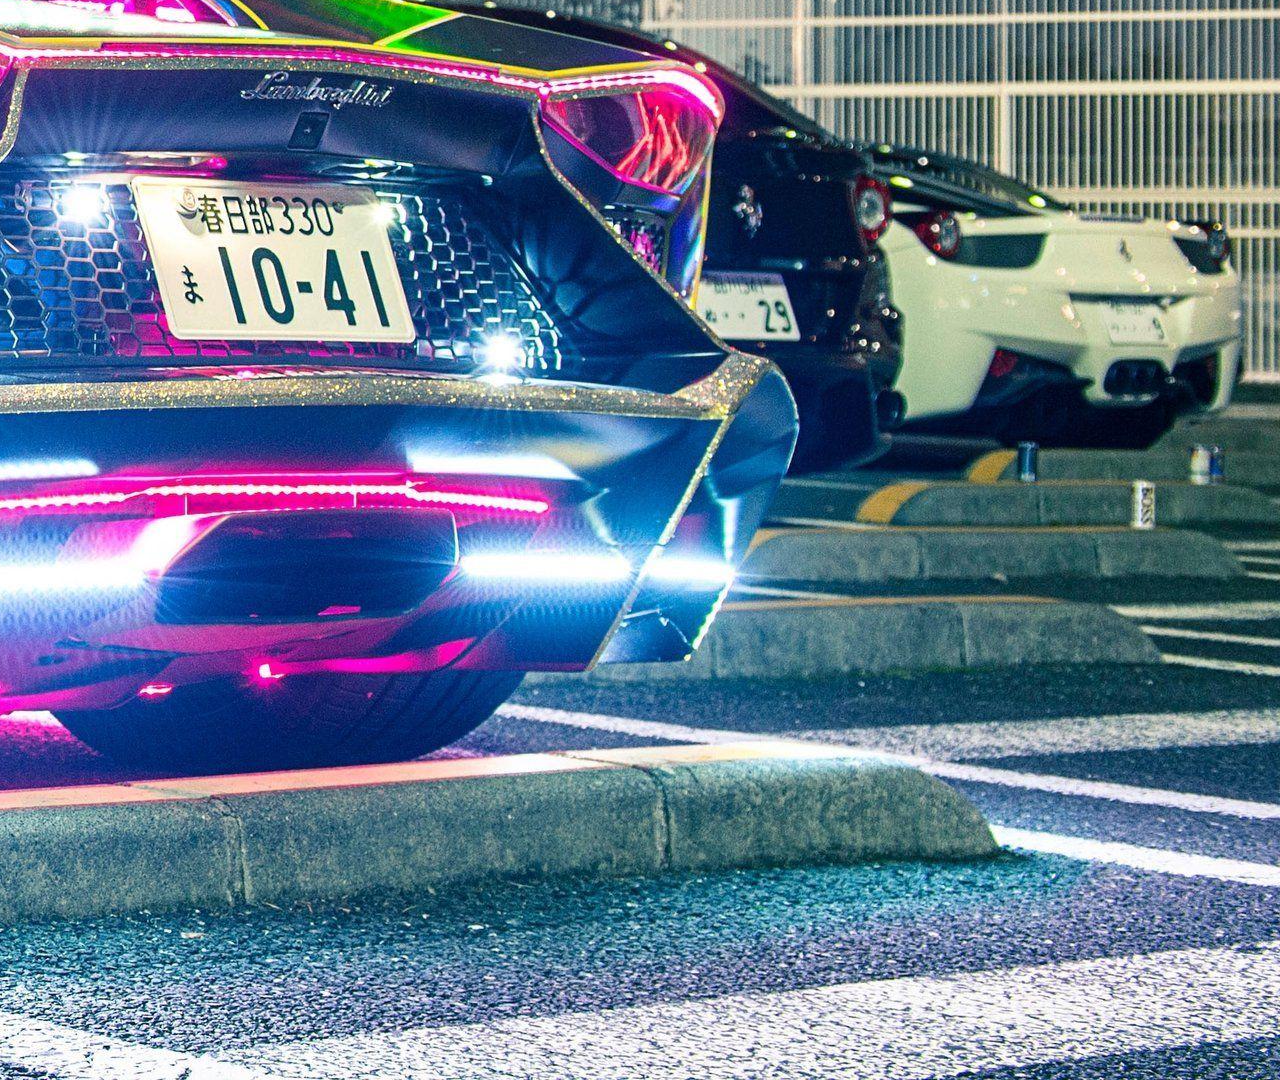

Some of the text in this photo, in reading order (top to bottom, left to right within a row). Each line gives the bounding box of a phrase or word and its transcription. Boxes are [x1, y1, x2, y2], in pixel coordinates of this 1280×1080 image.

[241, 71, 394, 110] Lamborghini
[181, 247, 390, 327] ま 10-41
